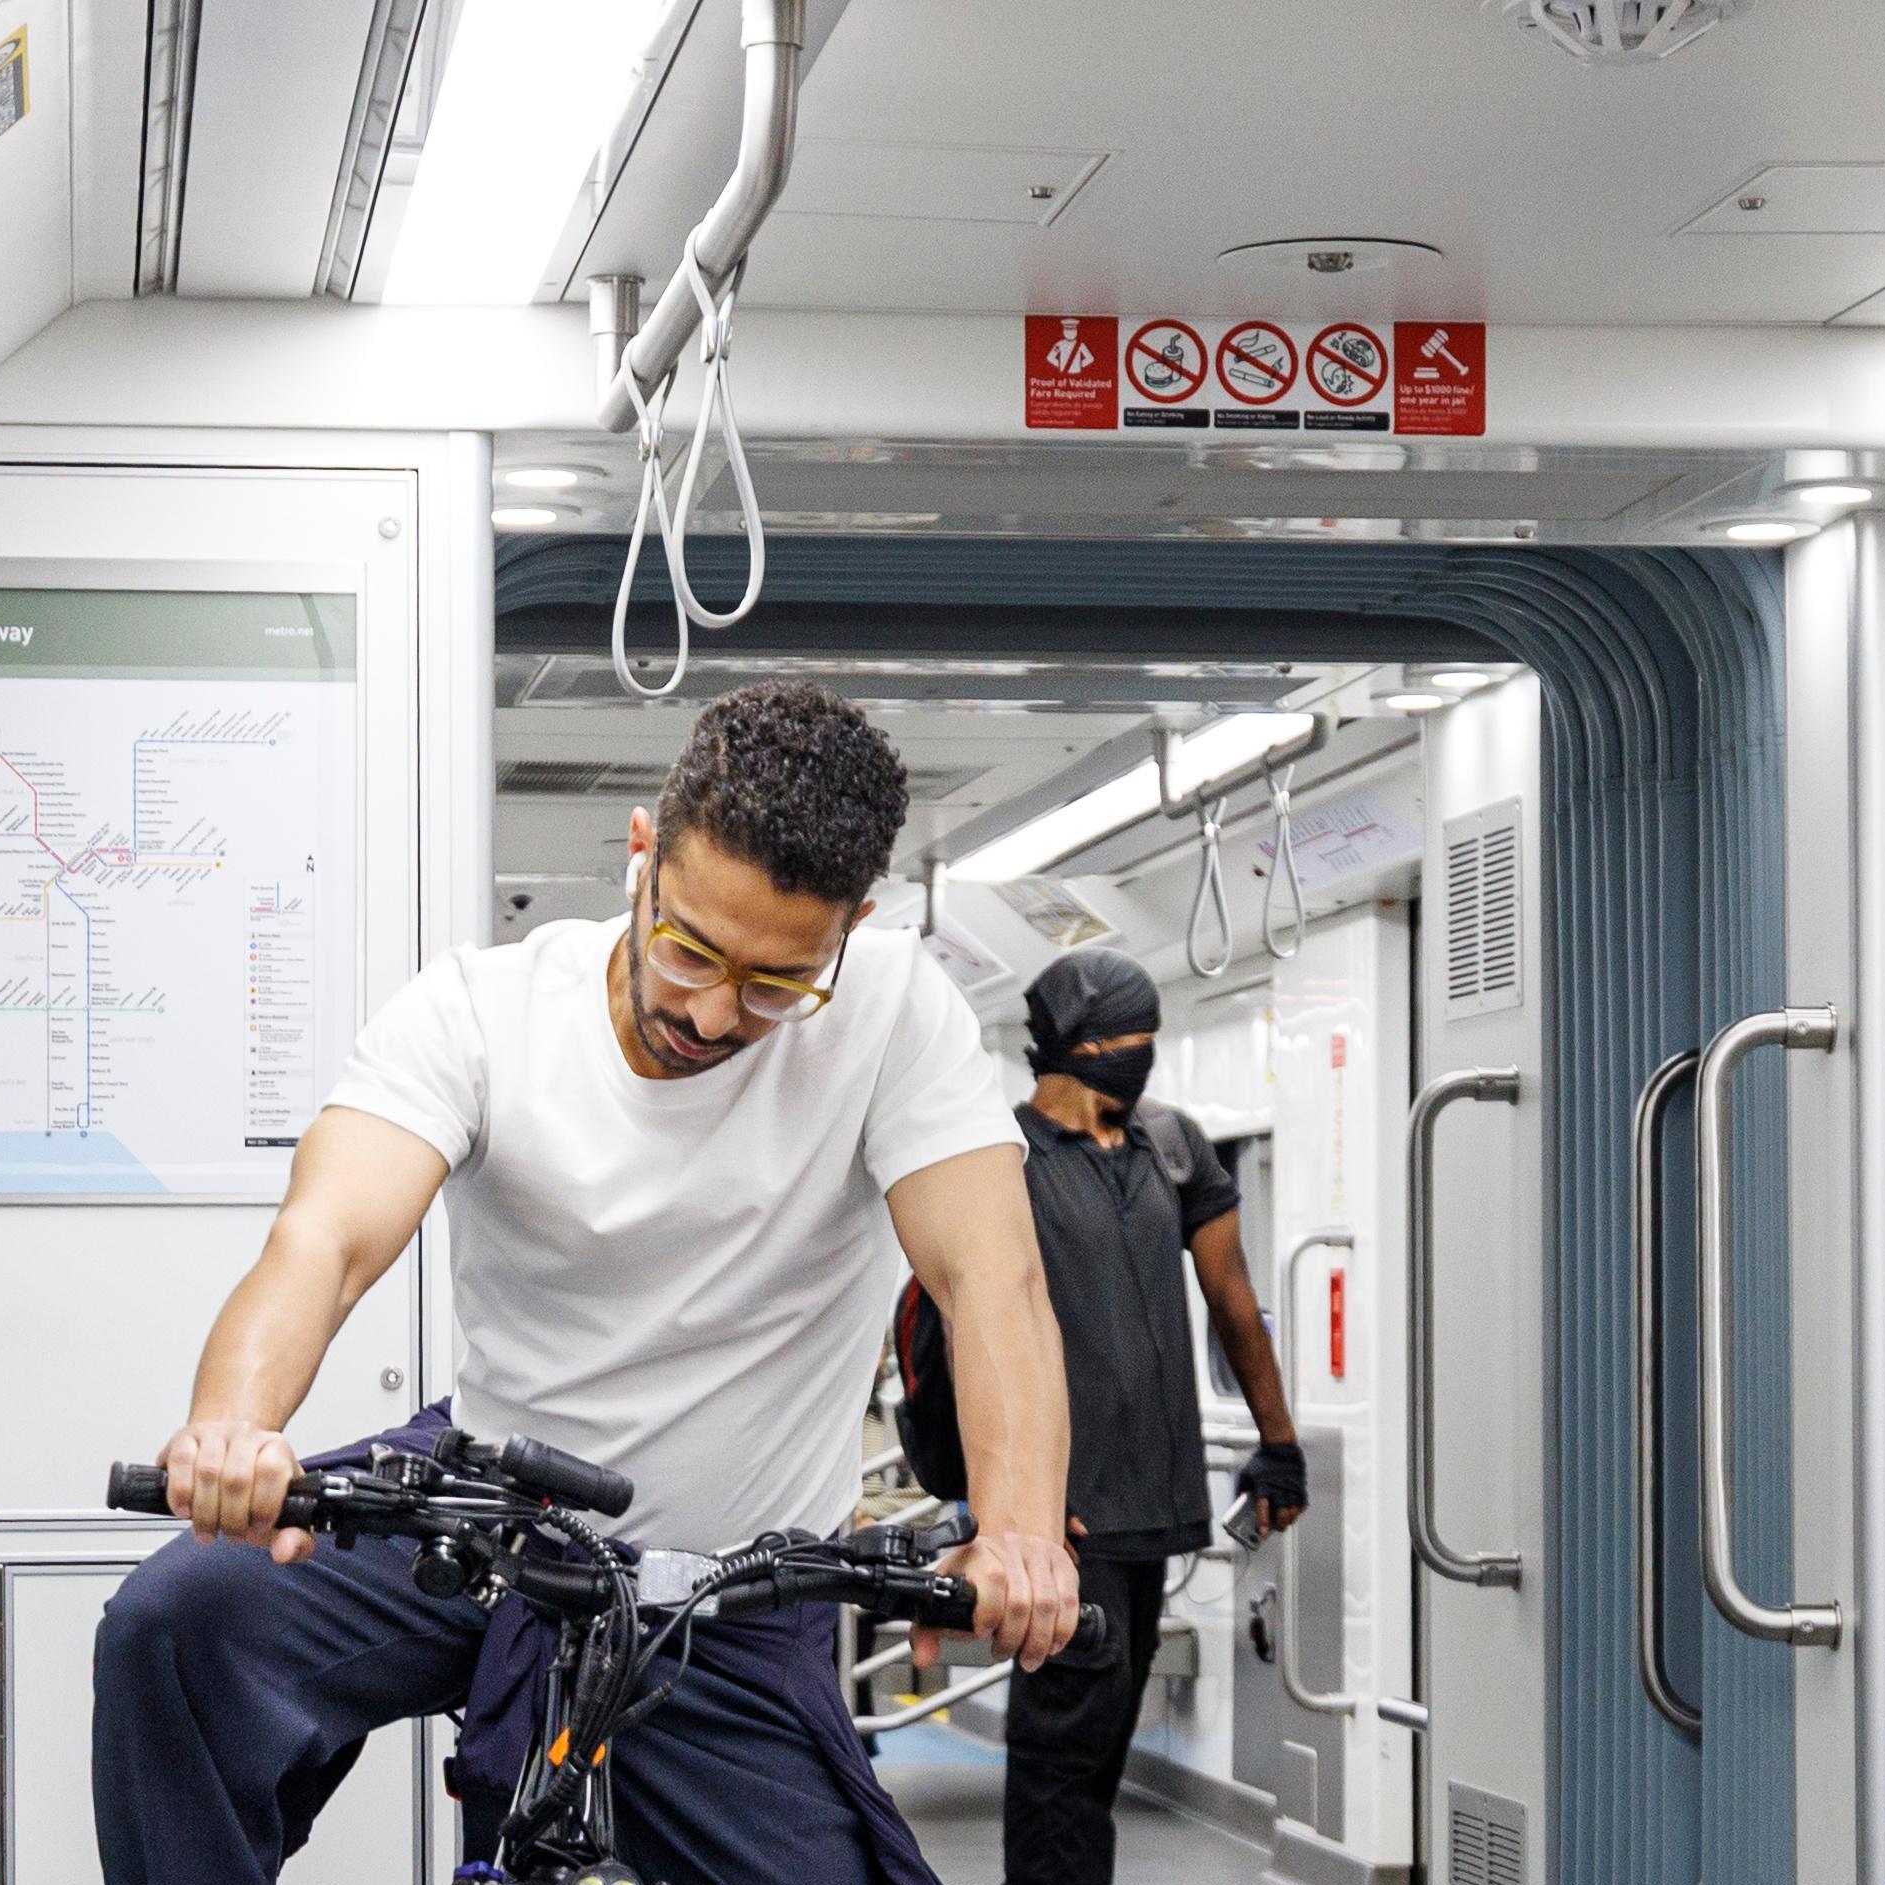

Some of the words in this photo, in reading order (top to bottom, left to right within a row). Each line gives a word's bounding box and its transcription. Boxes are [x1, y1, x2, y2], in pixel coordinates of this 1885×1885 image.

[1030, 377, 1055, 387] Proof
[1057, 378, 1067, 387] of
[1068, 378, 1112, 388] Validated
[1030, 387, 1052, 398] Fare
[1054, 388, 1097, 399] Required
[1399, 384, 1413, 396] Up
[1425, 384, 1452, 395] $1000
[1418, 397, 1439, 406] year
[1441, 396, 1450, 405] in
[1451, 397, 1467, 406] jail
[1160, 411, 1185, 420] Drinking
[264, 626, 314, 637] metro.net
[306, 862, 315, 872] N
